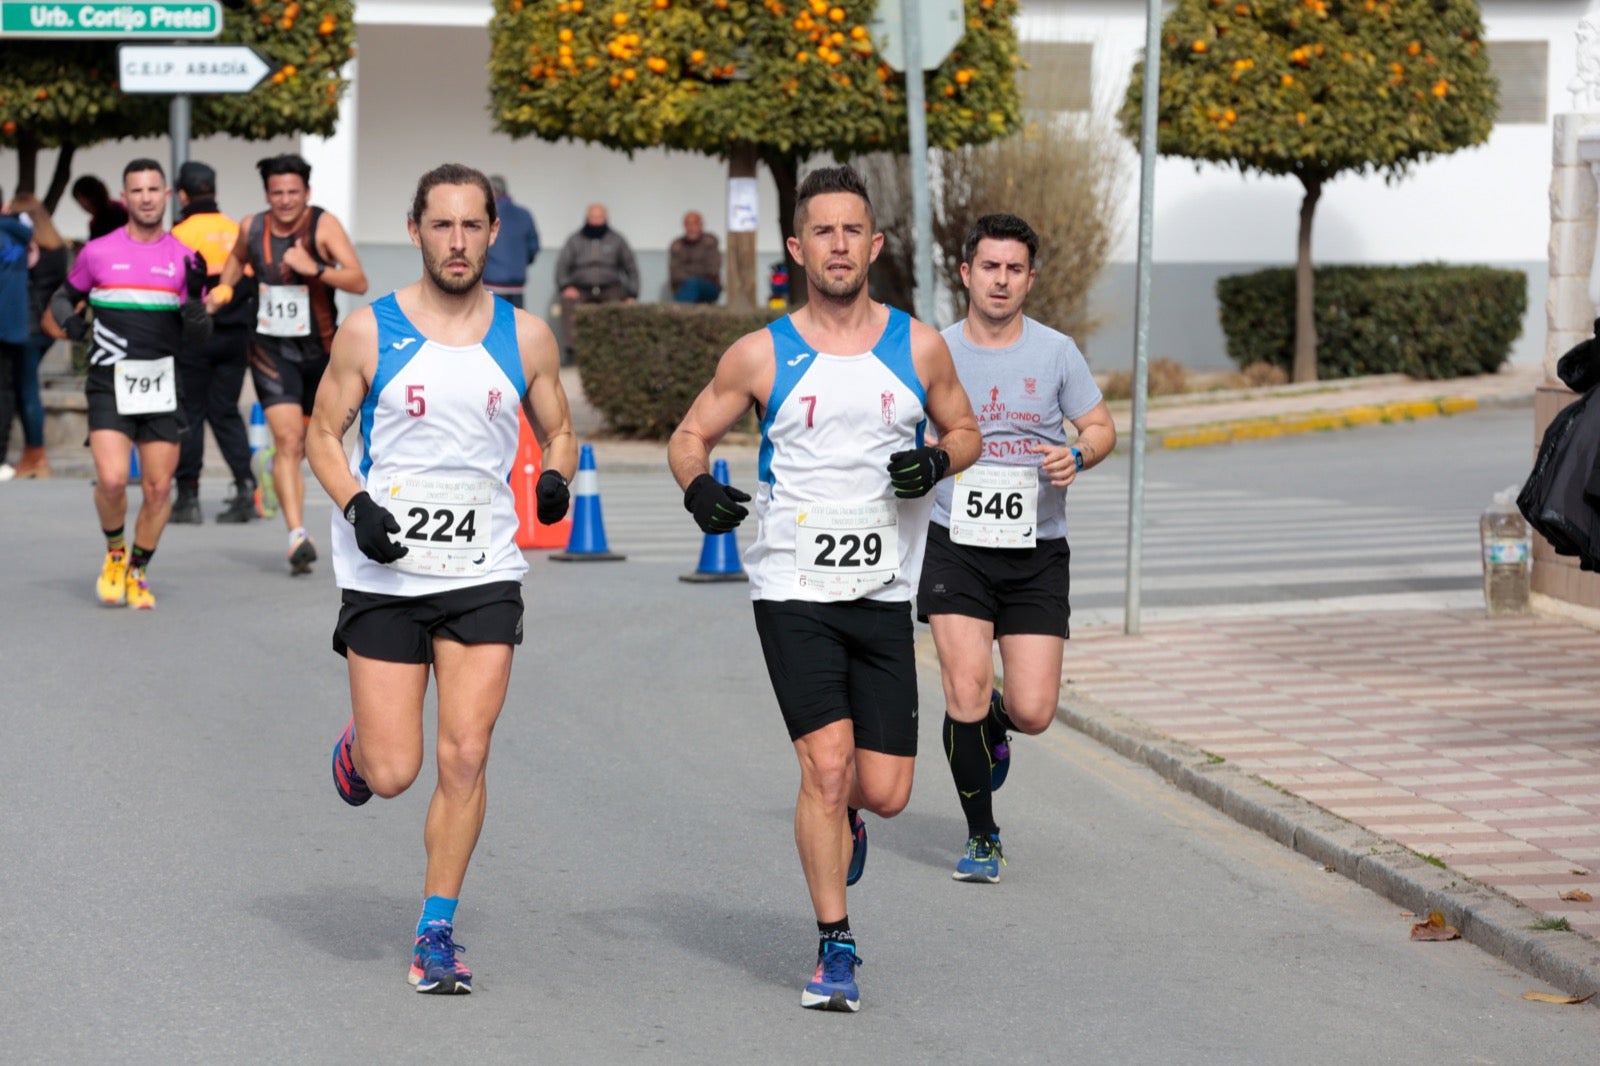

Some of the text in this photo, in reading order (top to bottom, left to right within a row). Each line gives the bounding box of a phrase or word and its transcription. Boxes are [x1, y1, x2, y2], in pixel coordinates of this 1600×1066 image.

[30, 5, 211, 31] Urb. Cortijo Pretel
[124, 372, 165, 394] 791
[405, 384, 427, 418] 5
[799, 395, 817, 429] 7
[982, 402, 1005, 413] XXVI
[990, 412, 1001, 421] DE
[1006, 411, 1041, 423] FONDO
[966, 491, 1023, 520] 546
[405, 507, 476, 543] 224
[814, 533, 882, 567] 229
